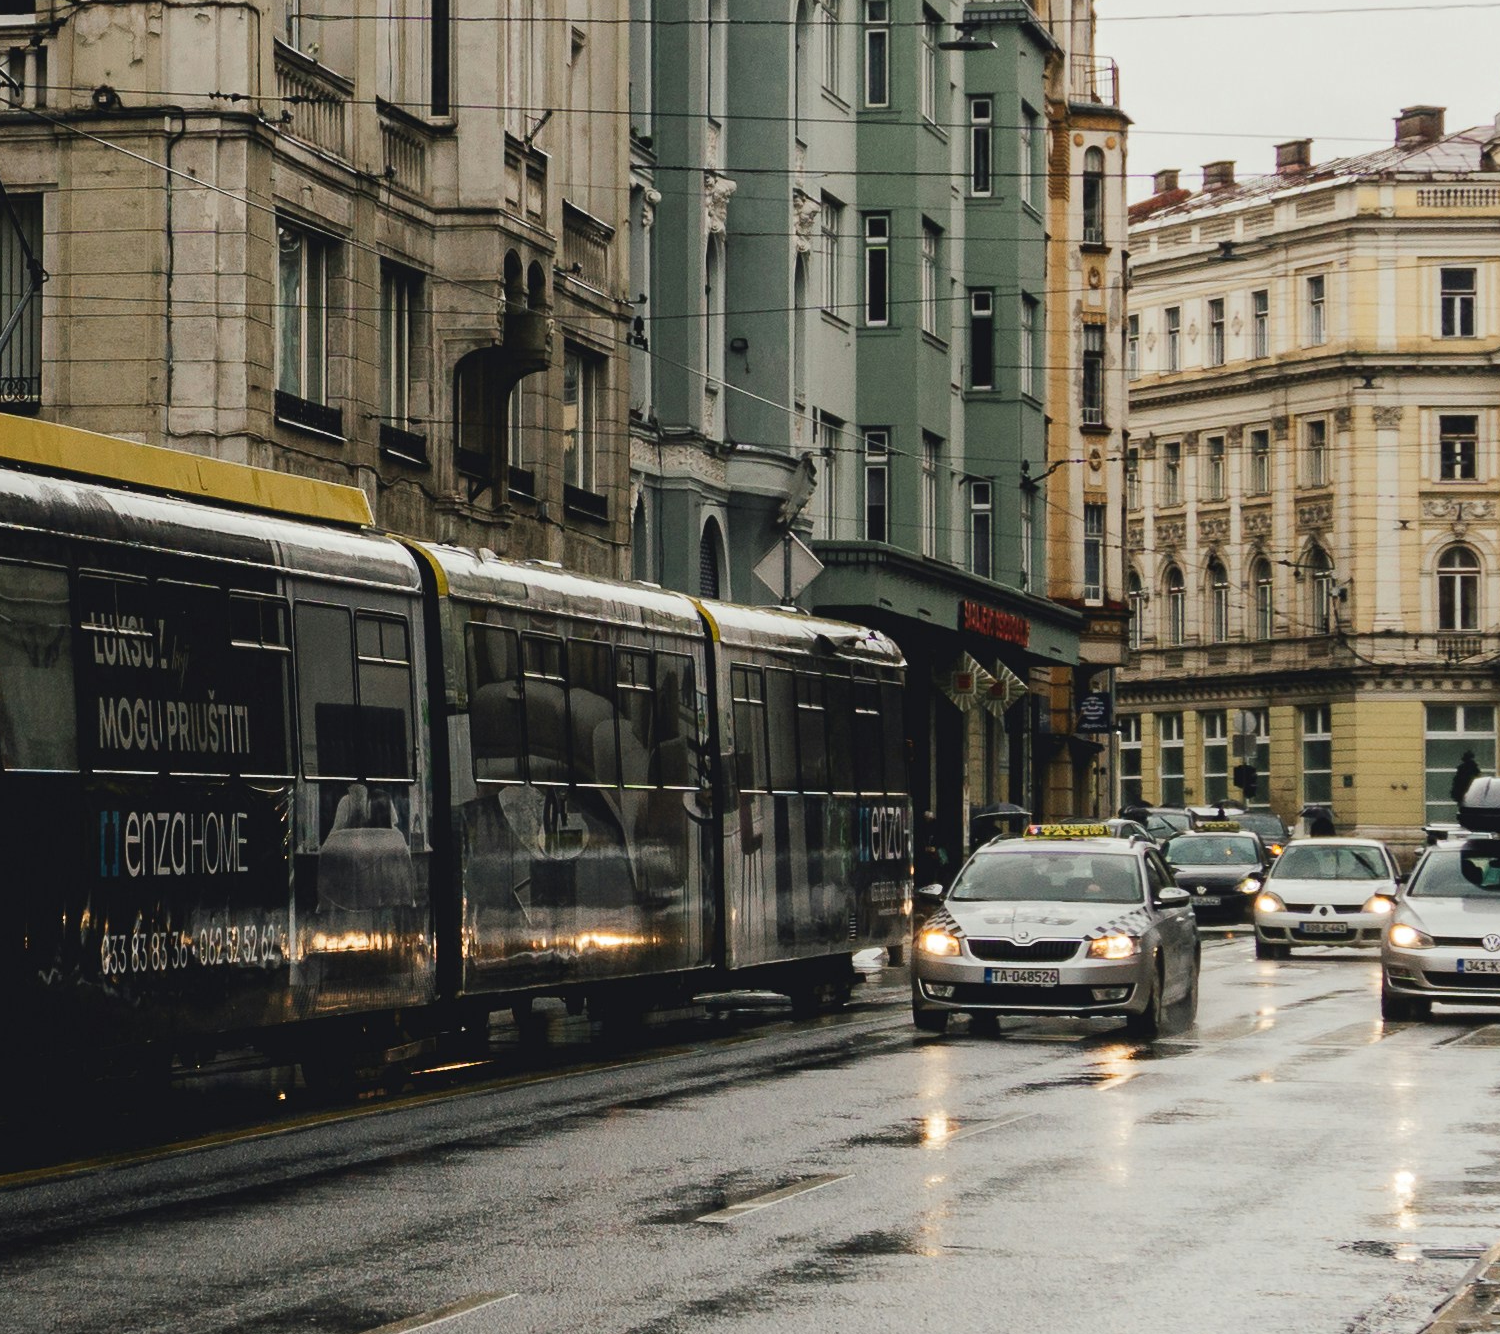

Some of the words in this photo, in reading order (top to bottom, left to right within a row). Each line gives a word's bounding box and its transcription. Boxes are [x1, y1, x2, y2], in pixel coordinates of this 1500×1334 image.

[166, 689, 250, 754] PRIUŠTITI
[125, 811, 186, 877] enza
[190, 812, 248, 874] HOME
[101, 934, 127, 975] 033
[131, 933, 147, 973] 83
[151, 932, 168, 971] 83
[172, 931, 188, 969] 36
[200, 927, 223, 966] 062
[226, 926, 241, 964] 52
[243, 925, 258, 963] 52
[261, 924, 275, 961] 62
[992, 970, 1057, 983] TA-048526
